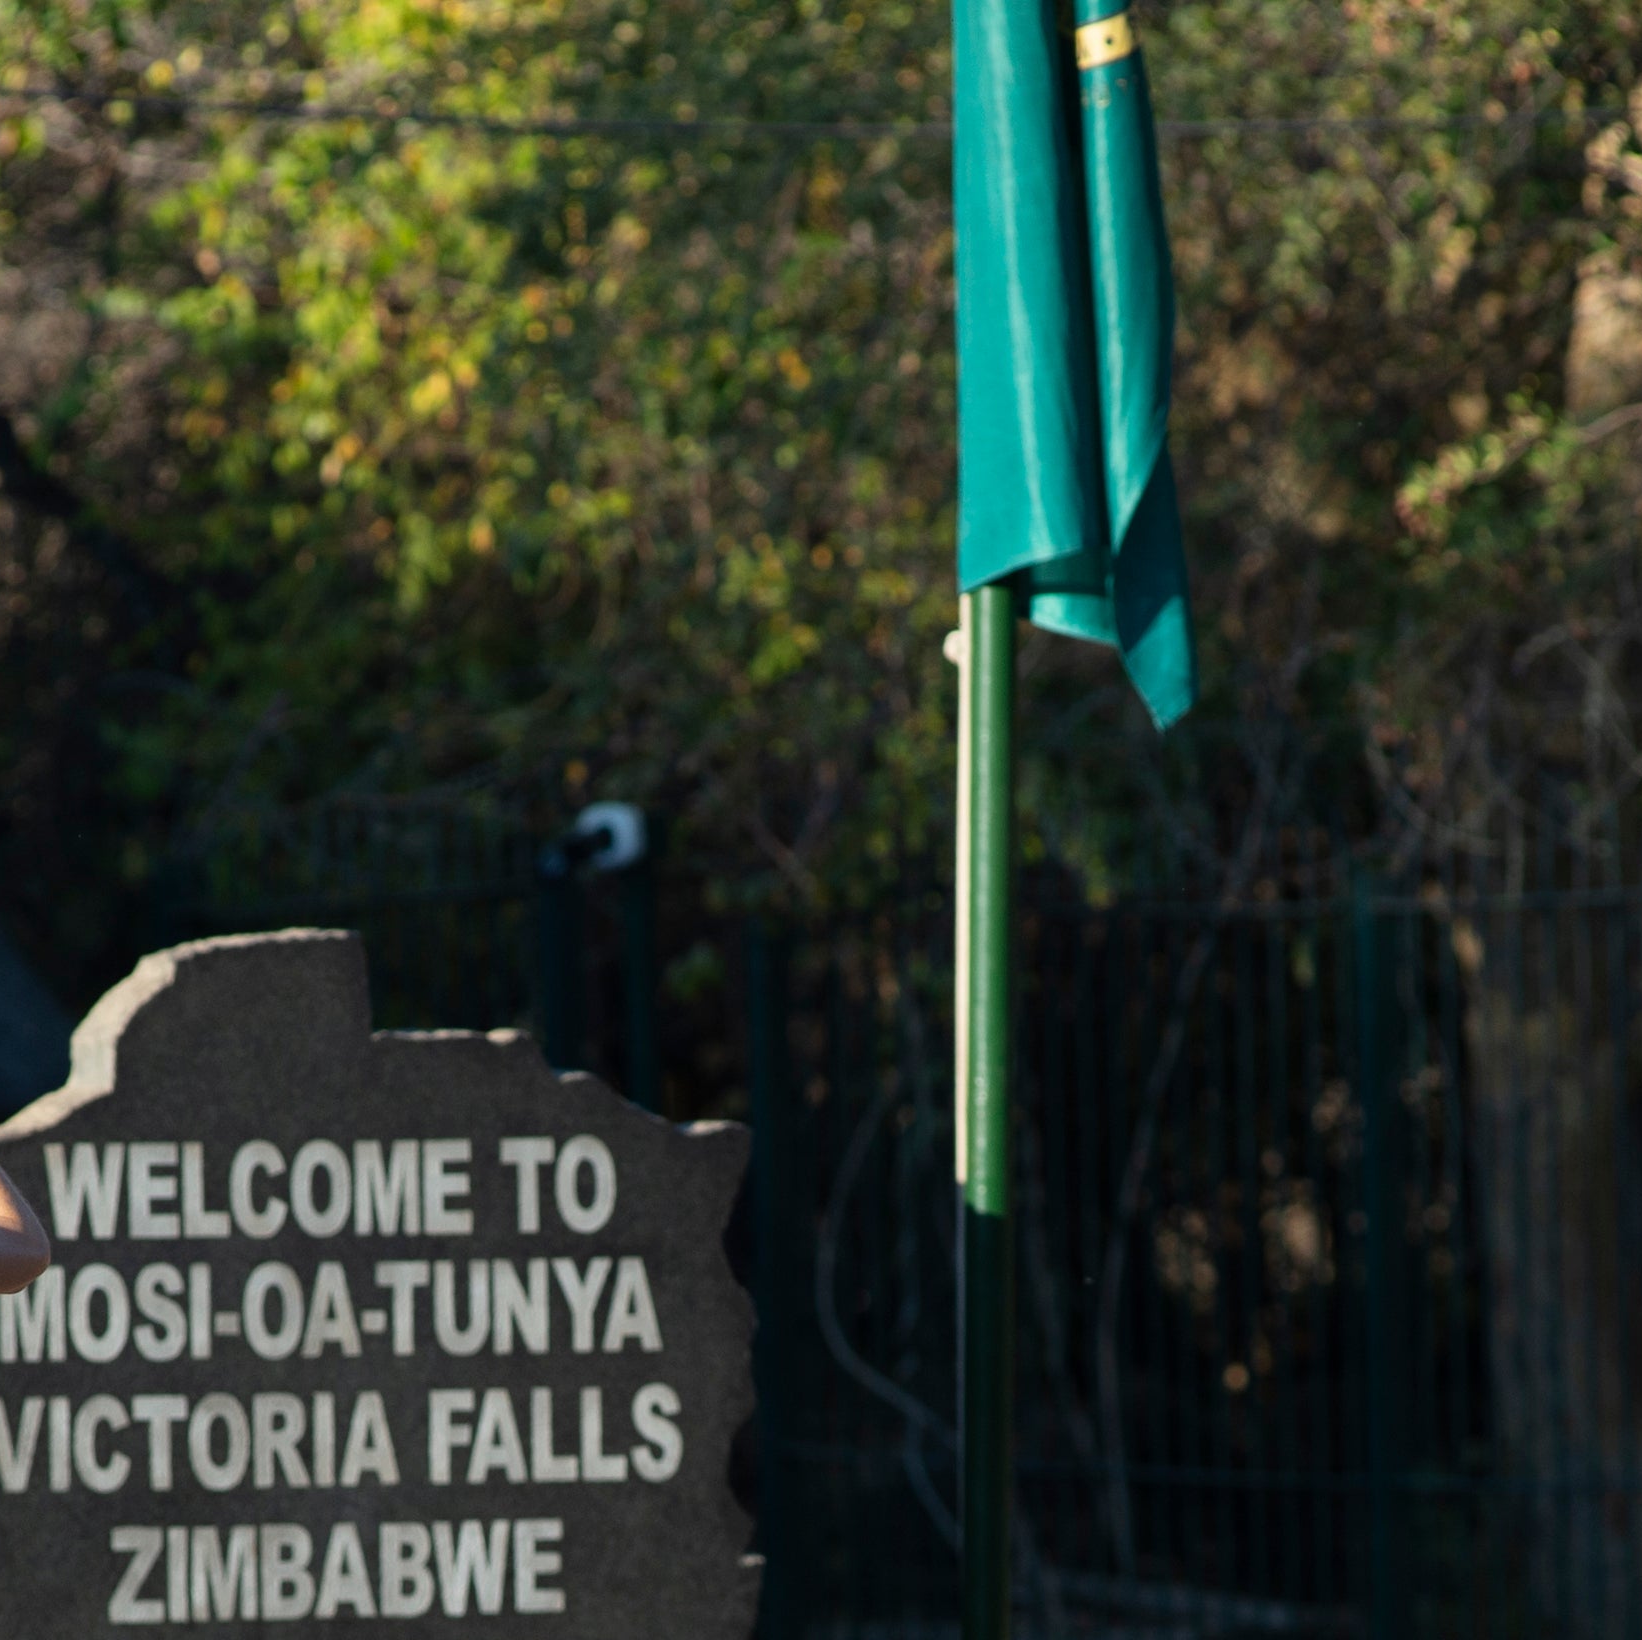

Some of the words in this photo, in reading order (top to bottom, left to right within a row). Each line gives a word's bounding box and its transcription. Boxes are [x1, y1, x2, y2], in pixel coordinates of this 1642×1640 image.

[43, 1137, 474, 1241] WELCOME
[499, 1134, 618, 1237] TO
[428, 1383, 684, 1485] FALLS
[107, 1517, 567, 1626] ZIMBABWE
